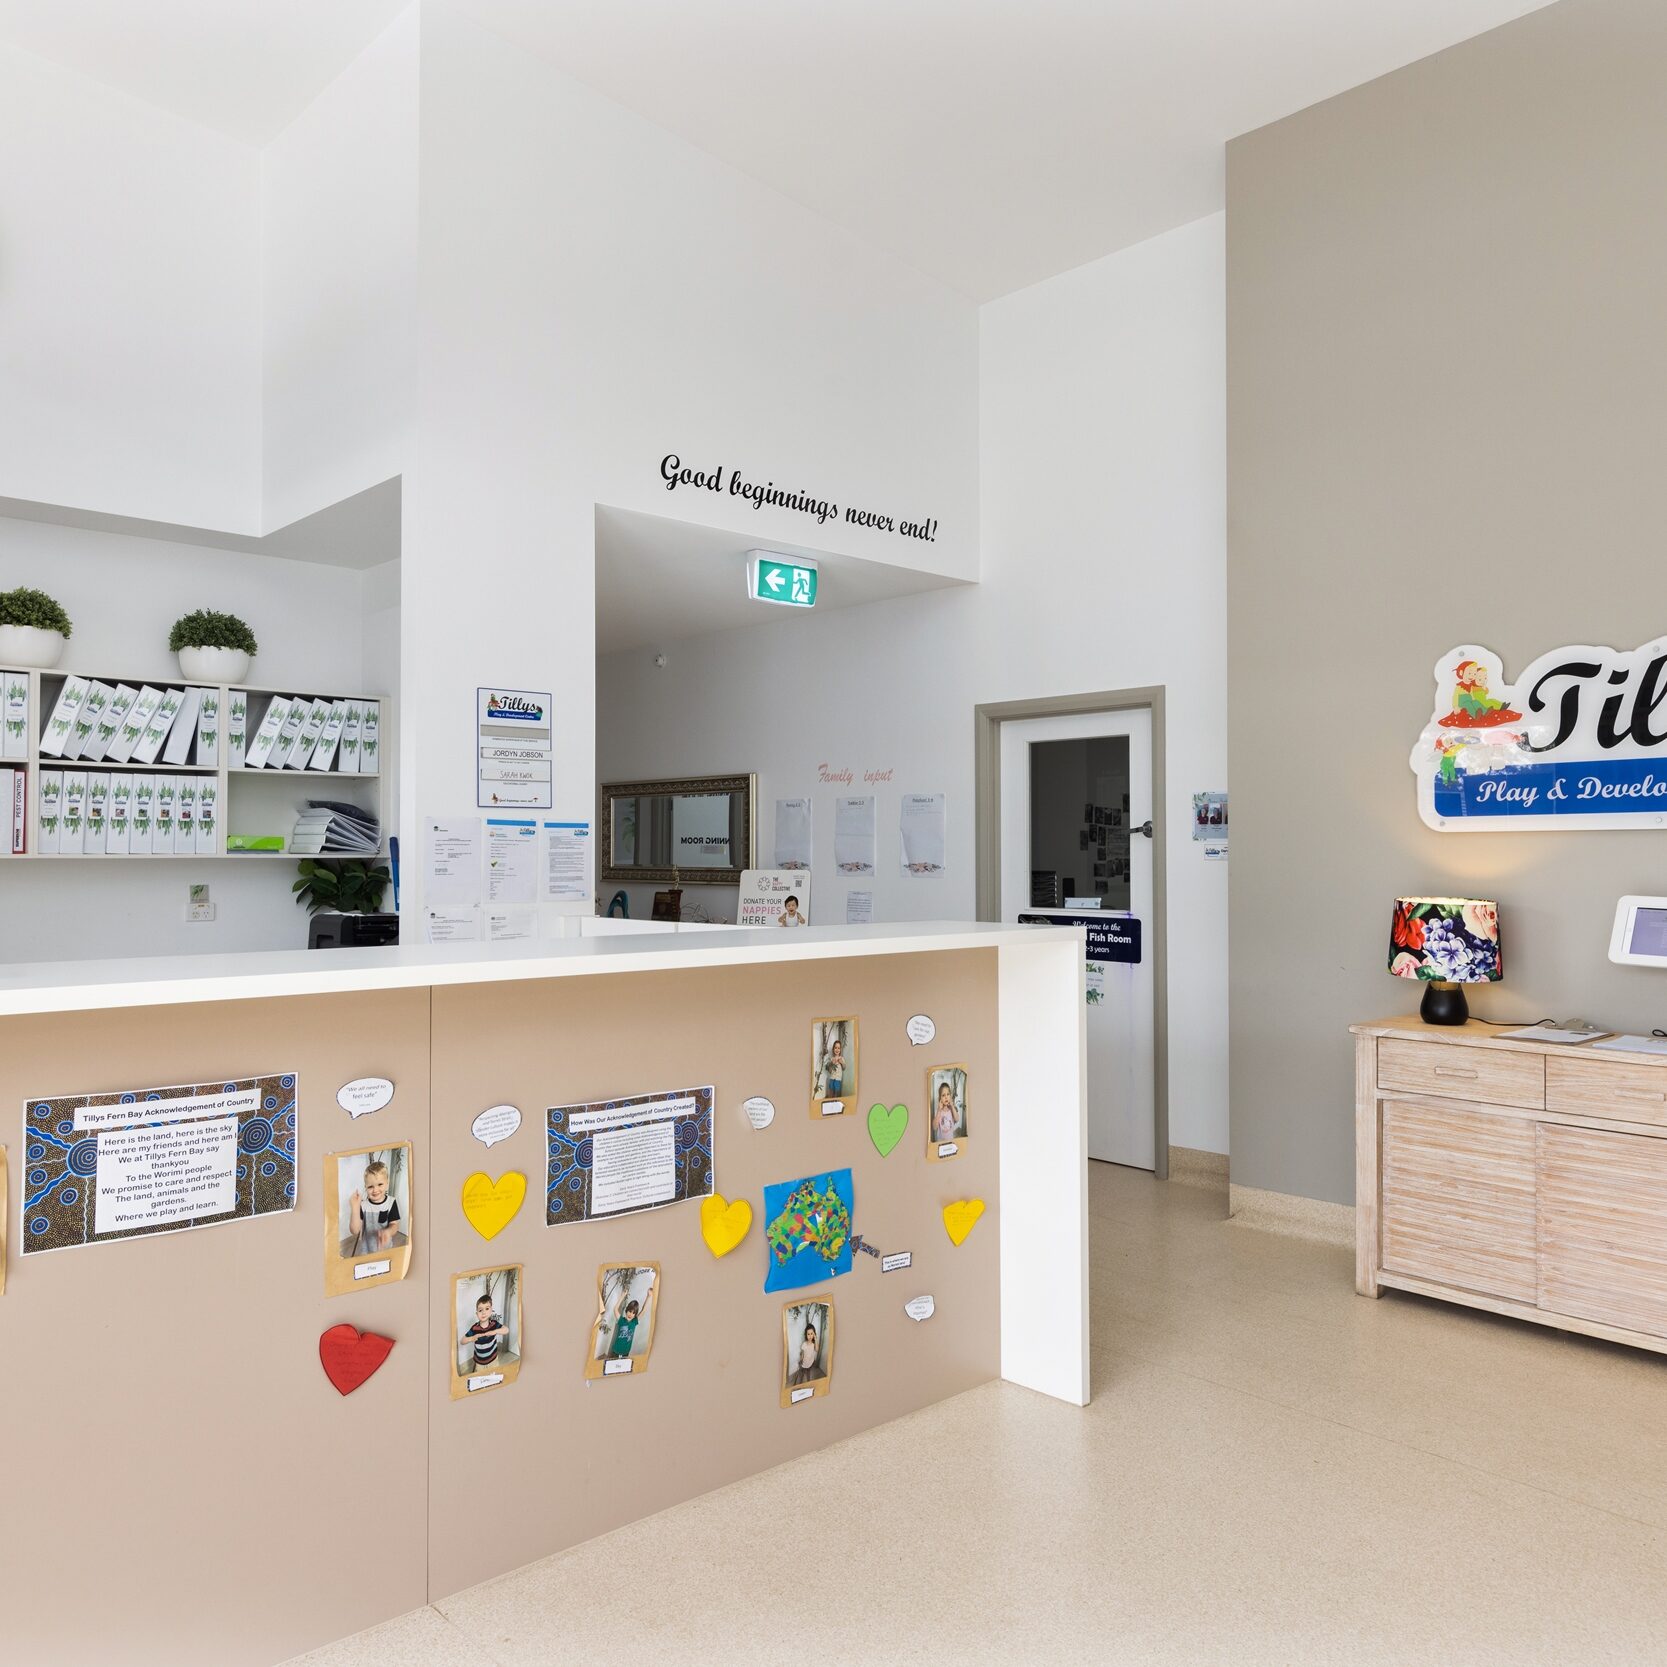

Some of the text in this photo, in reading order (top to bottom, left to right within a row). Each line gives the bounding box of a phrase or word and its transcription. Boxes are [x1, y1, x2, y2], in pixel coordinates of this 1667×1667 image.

[660, 454, 938, 542] Good beginnings never end!
[498, 696, 536, 713] Tillys
[492, 750, 518, 758] JORDYN
[500, 770, 518, 779] SARAH
[818, 763, 894, 787] Family input
[1476, 774, 1667, 808] Play & Develo
[742, 906, 781, 914] NAPPIES
[742, 916, 766, 924] HERE
[1110, 922, 1120, 931] the
[1090, 932, 1132, 943] Fish Room
[83, 1096, 254, 1122] Tillys Fern Bay Acknowledgement of Country
[606, 1110, 648, 1122] Acknowledgement
[654, 1106, 672, 1114] Country
[673, 1102, 695, 1111] Created?
[104, 1124, 232, 1145] Here is the land, here is the sky
[98, 1147, 117, 1156] Here
[119, 1146, 134, 1154] are
[136, 1144, 151, 1154] my
[153, 1139, 183, 1150] friends
[185, 1137, 200, 1146] and
[202, 1135, 219, 1144] here
[118, 1156, 132, 1164] We
[145, 1151, 166, 1162] Tillys
[168, 1149, 187, 1158] Fern
[189, 1146, 204, 1156] Bay
[207, 1144, 220, 1154] say
[126, 1164, 212, 1182] To the Worimi people
[151, 1159, 189, 1170] thankyou
[101, 1187, 115, 1196] We
[117, 1183, 151, 1196] promise
[163, 1179, 183, 1187] care
[186, 1176, 200, 1185] and
[202, 1170, 232, 1183] respect
[116, 1182, 220, 1203] The land, animals and the
[115, 1213, 143, 1222] Where
[160, 1207, 177, 1218] play
[179, 1205, 194, 1214] and
[196, 1202, 219, 1211] learn.
[151, 1198, 186, 1210] gardens.
